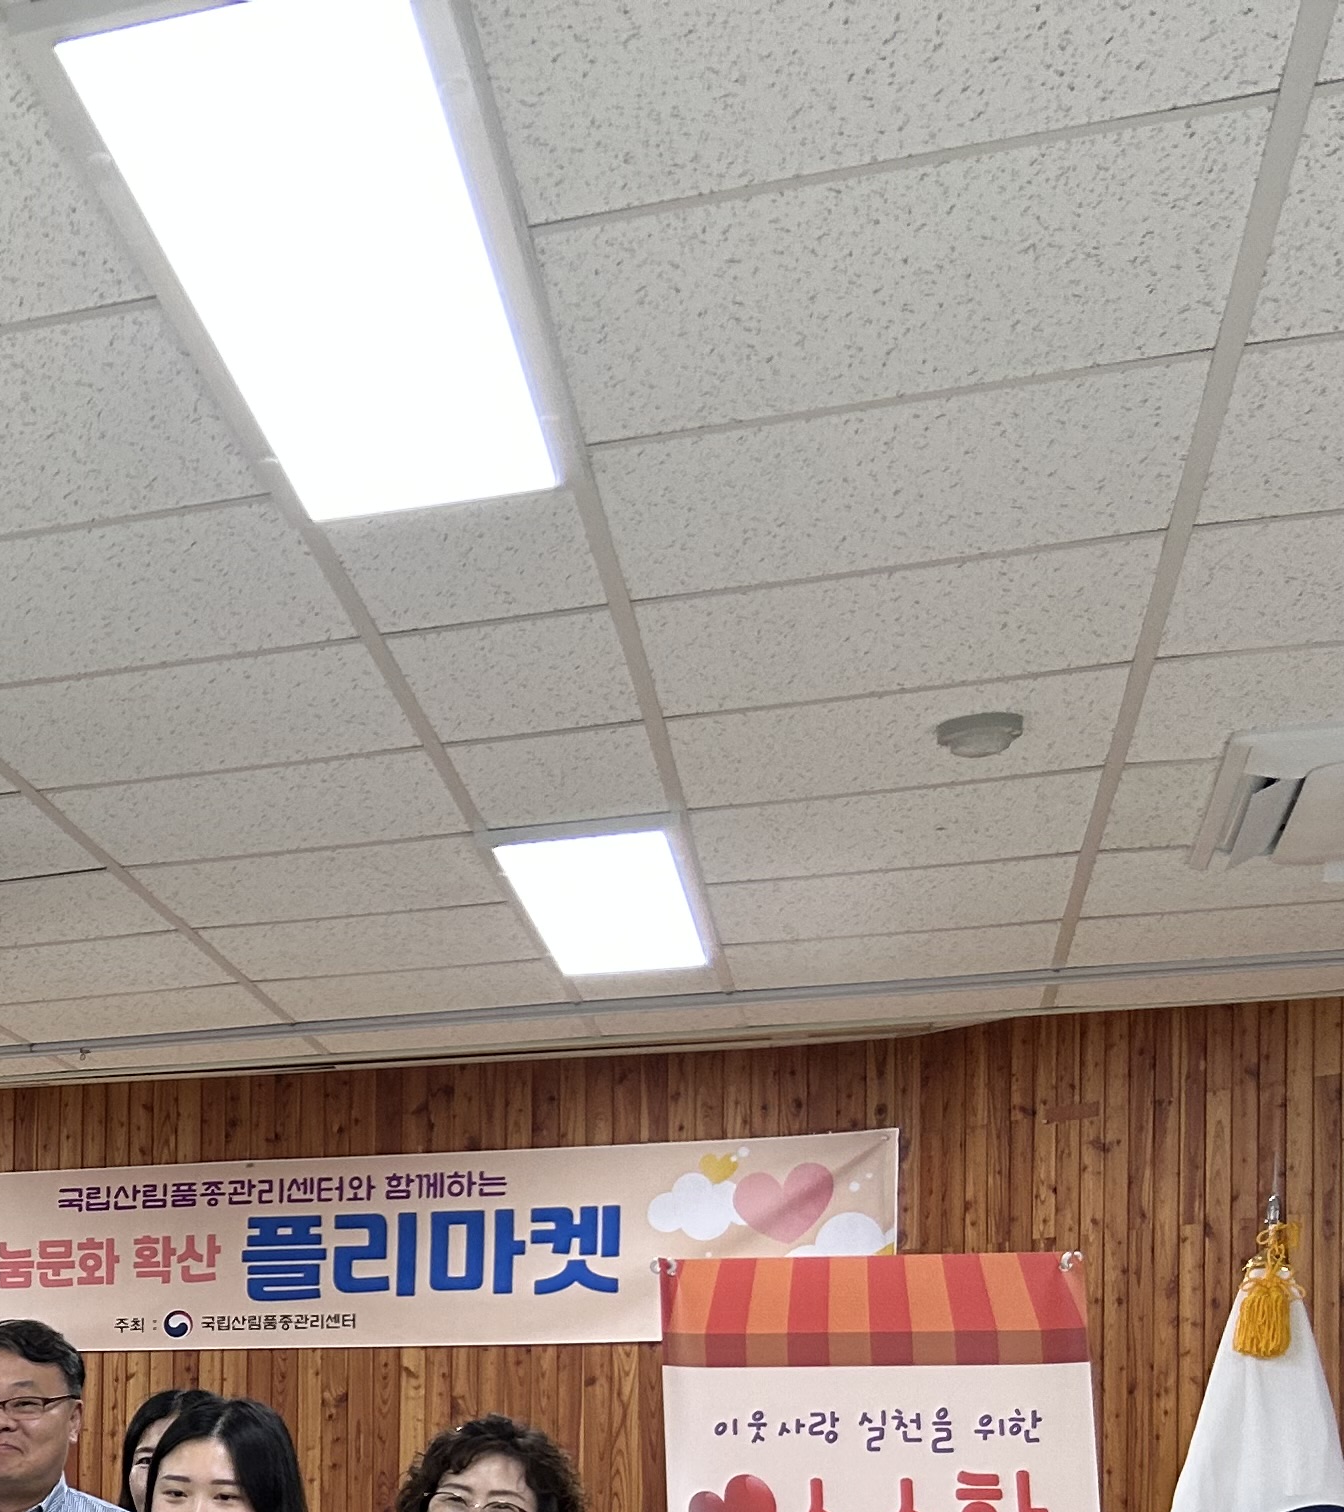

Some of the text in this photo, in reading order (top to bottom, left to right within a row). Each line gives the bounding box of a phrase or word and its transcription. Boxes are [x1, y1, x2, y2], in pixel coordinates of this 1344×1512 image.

[57, 1170, 507, 1213] 국립산림품종관리센터와 함께하는
[132, 1233, 223, 1286] 확산
[242, 1204, 621, 1302] 플리마켓
[114, 1317, 145, 1333] 주최
[201, 1313, 356, 1331] 국립산림품종관리센터
[714, 1407, 1043, 1454] 이웃사랑 실천을 위한
